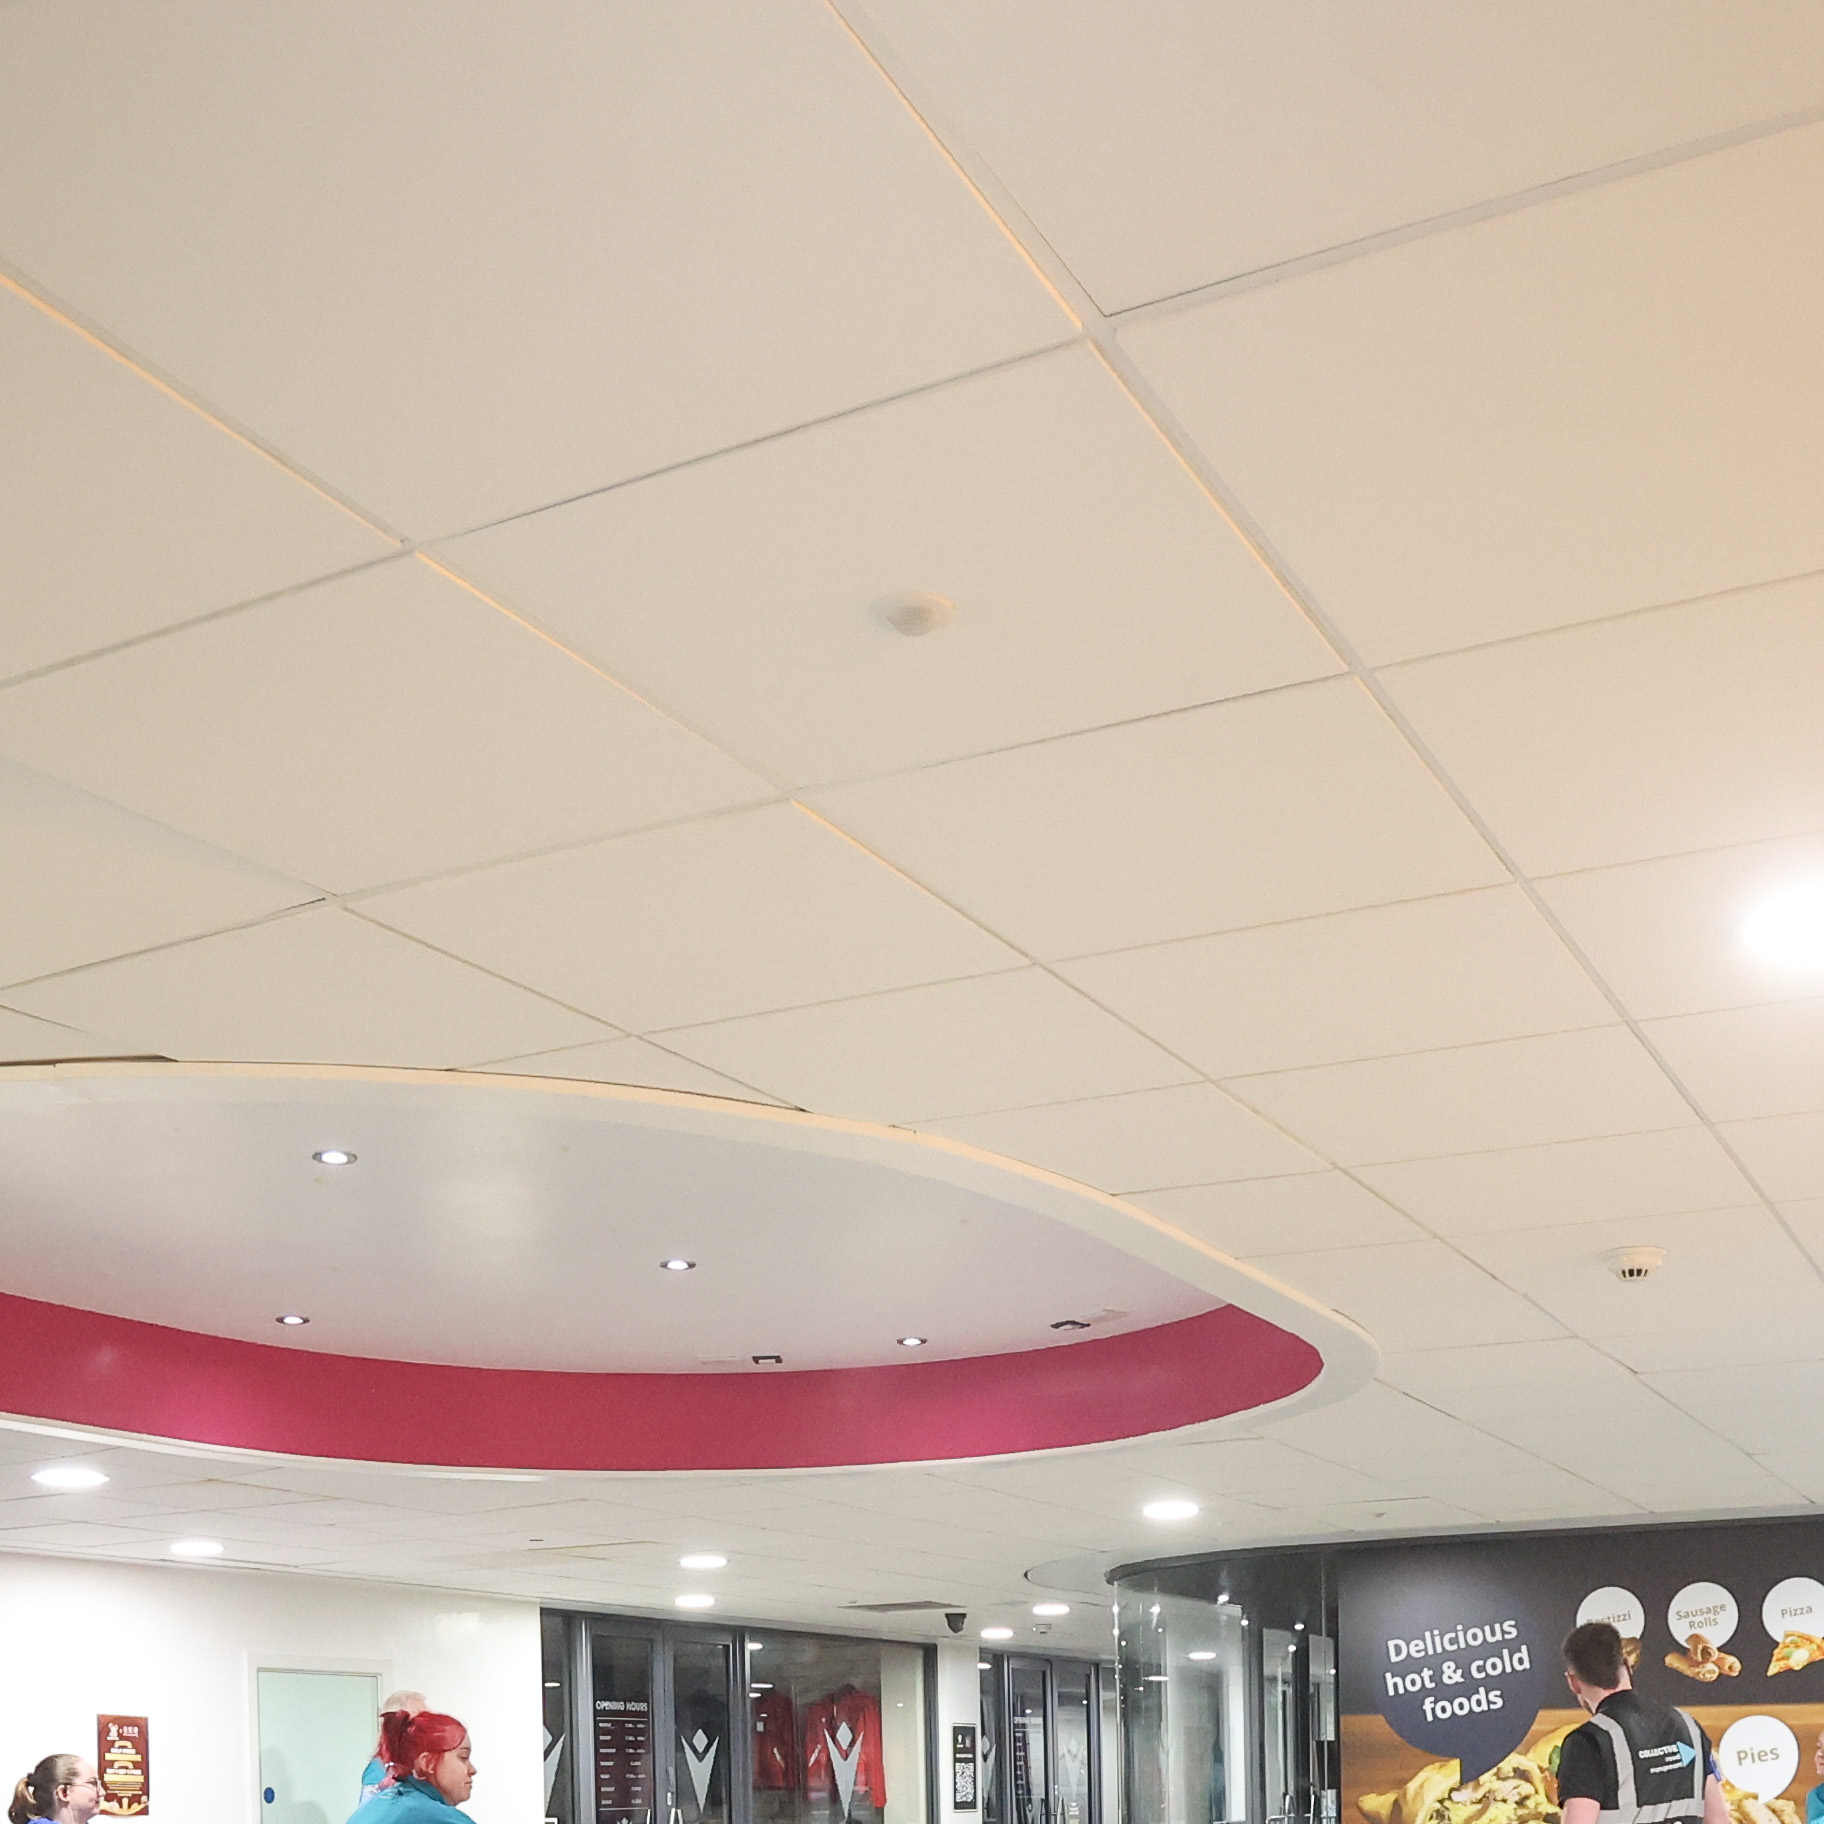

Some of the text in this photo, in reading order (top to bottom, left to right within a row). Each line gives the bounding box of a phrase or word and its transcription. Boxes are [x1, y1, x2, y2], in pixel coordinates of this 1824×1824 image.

[1676, 1602, 1727, 1621] Sausage
[1781, 1604, 1814, 1619] Pizza
[1688, 1617, 1719, 1631] Rolls
[1387, 1620, 1518, 1662] Delicious
[1384, 1644, 1531, 1696] hot & cold
[1422, 1686, 1504, 1722] foods
[1736, 1747, 1780, 1767] Pies
